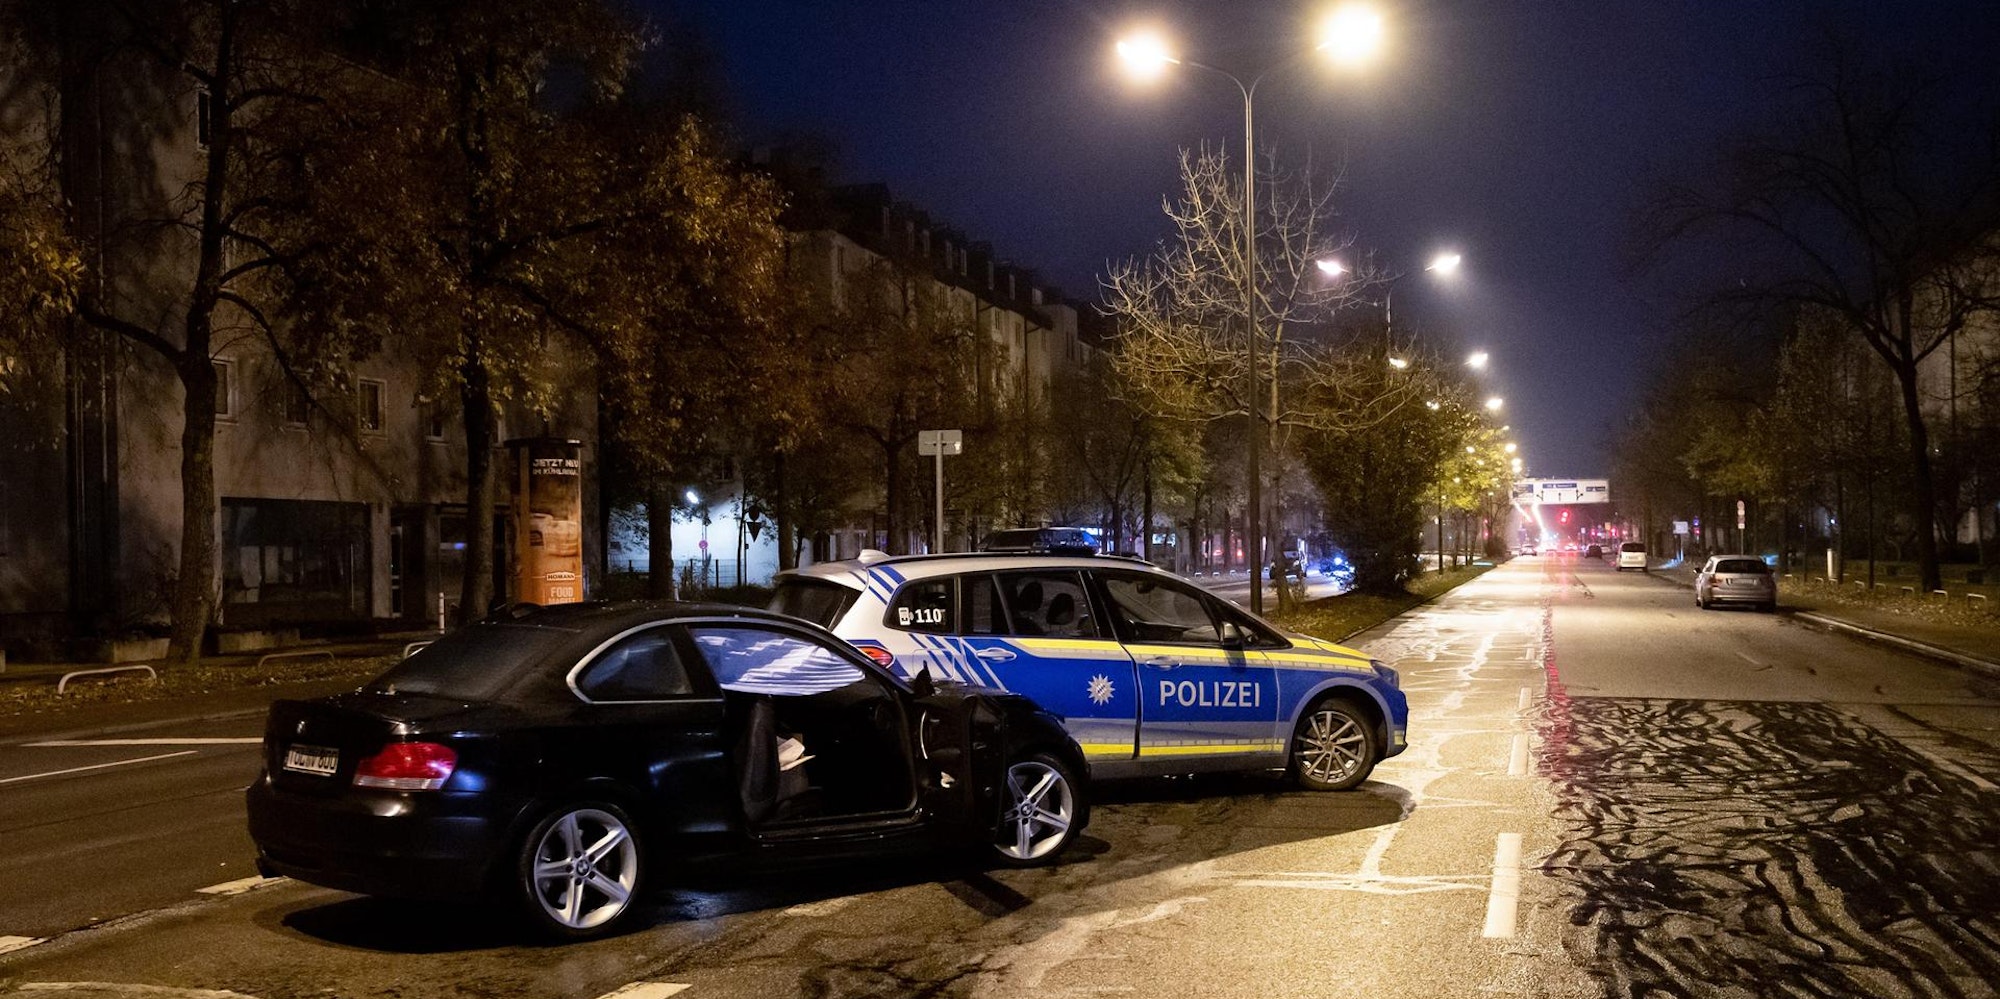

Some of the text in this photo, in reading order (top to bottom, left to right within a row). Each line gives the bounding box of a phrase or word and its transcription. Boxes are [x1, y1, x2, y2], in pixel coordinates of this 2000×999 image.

[533, 458, 563, 467] JETZT
[551, 586, 574, 597] FOOD
[915, 608, 942, 623] 110
[1160, 680, 1259, 707] POLIZEI
